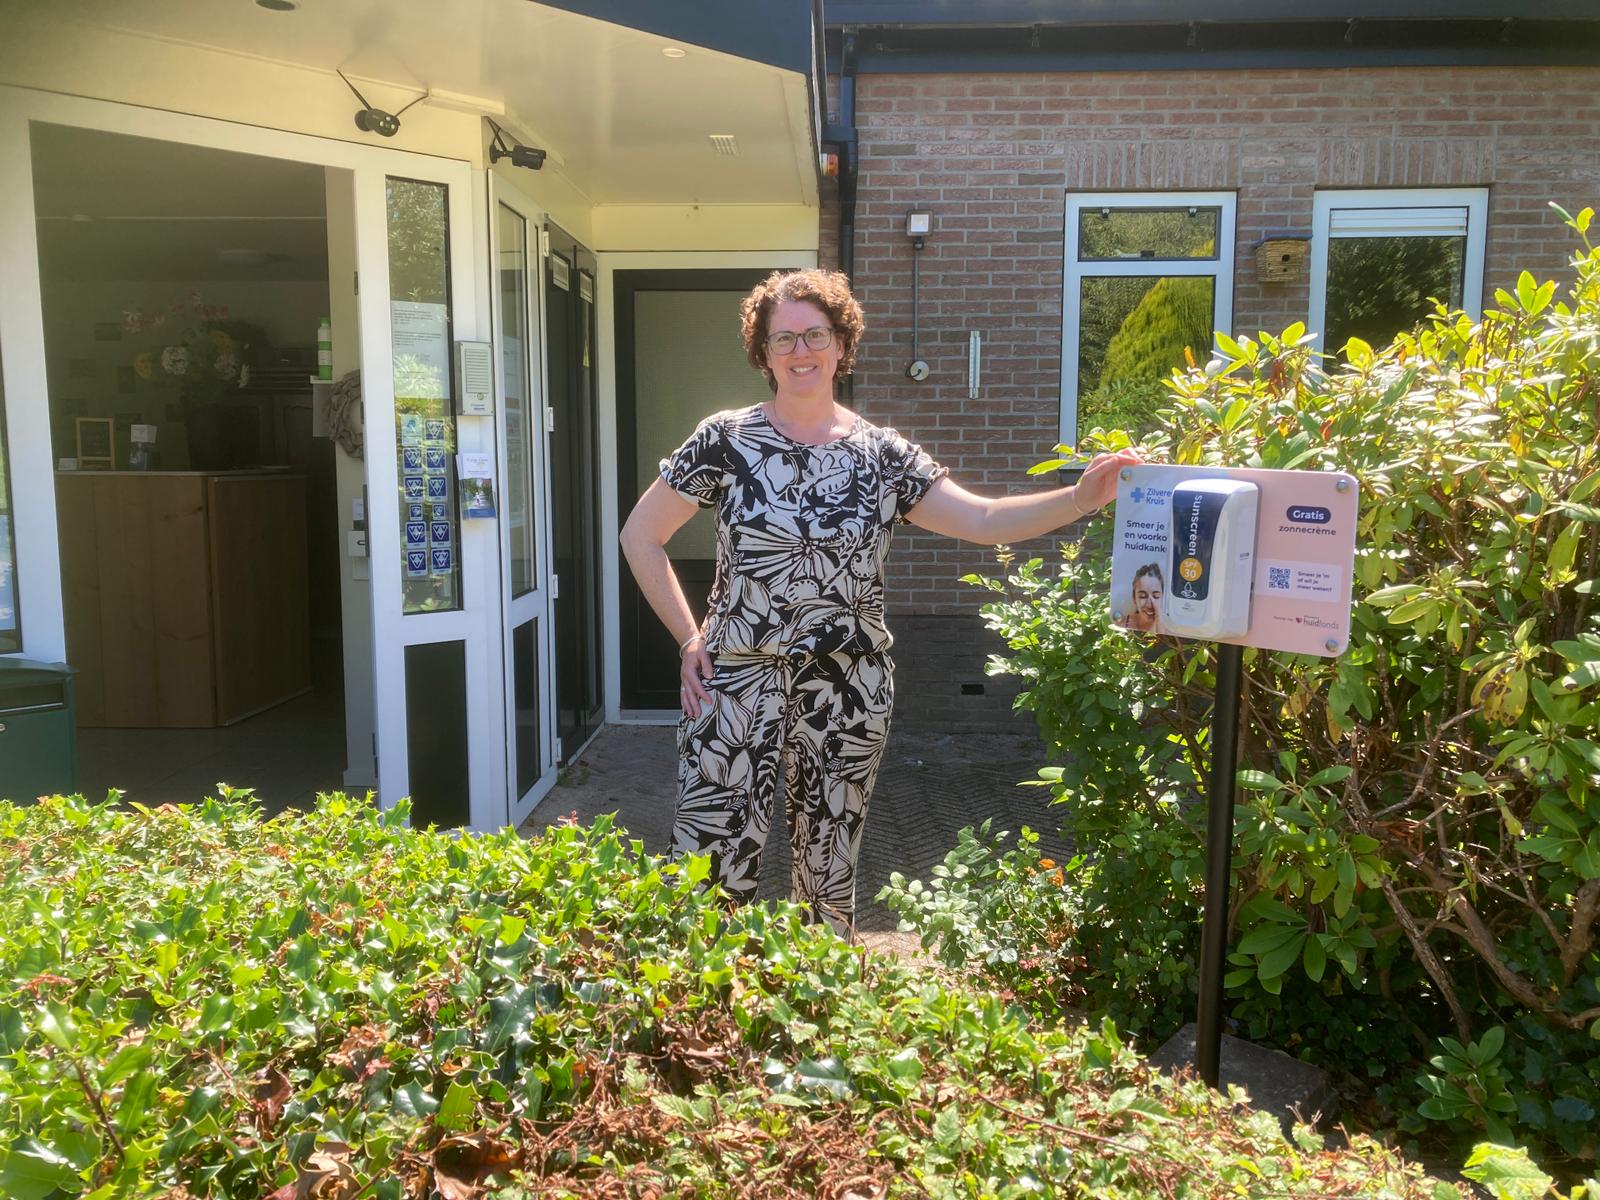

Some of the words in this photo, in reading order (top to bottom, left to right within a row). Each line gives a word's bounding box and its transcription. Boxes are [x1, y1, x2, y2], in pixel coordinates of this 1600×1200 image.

[1146, 487, 1173, 497] Zilvere
[1145, 497, 1165, 505] Kruis
[1292, 510, 1325, 520] Gratis
[1126, 520, 1155, 530] Smeer
[1155, 521, 1165, 532] je
[1188, 495, 1203, 556] sunscreen
[1279, 525, 1337, 536] zonnecrème
[1124, 532, 1136, 540] en
[1137, 532, 1168, 542] voorko
[1124, 542, 1168, 553] huidkank
[1184, 568, 1197, 578] 30
